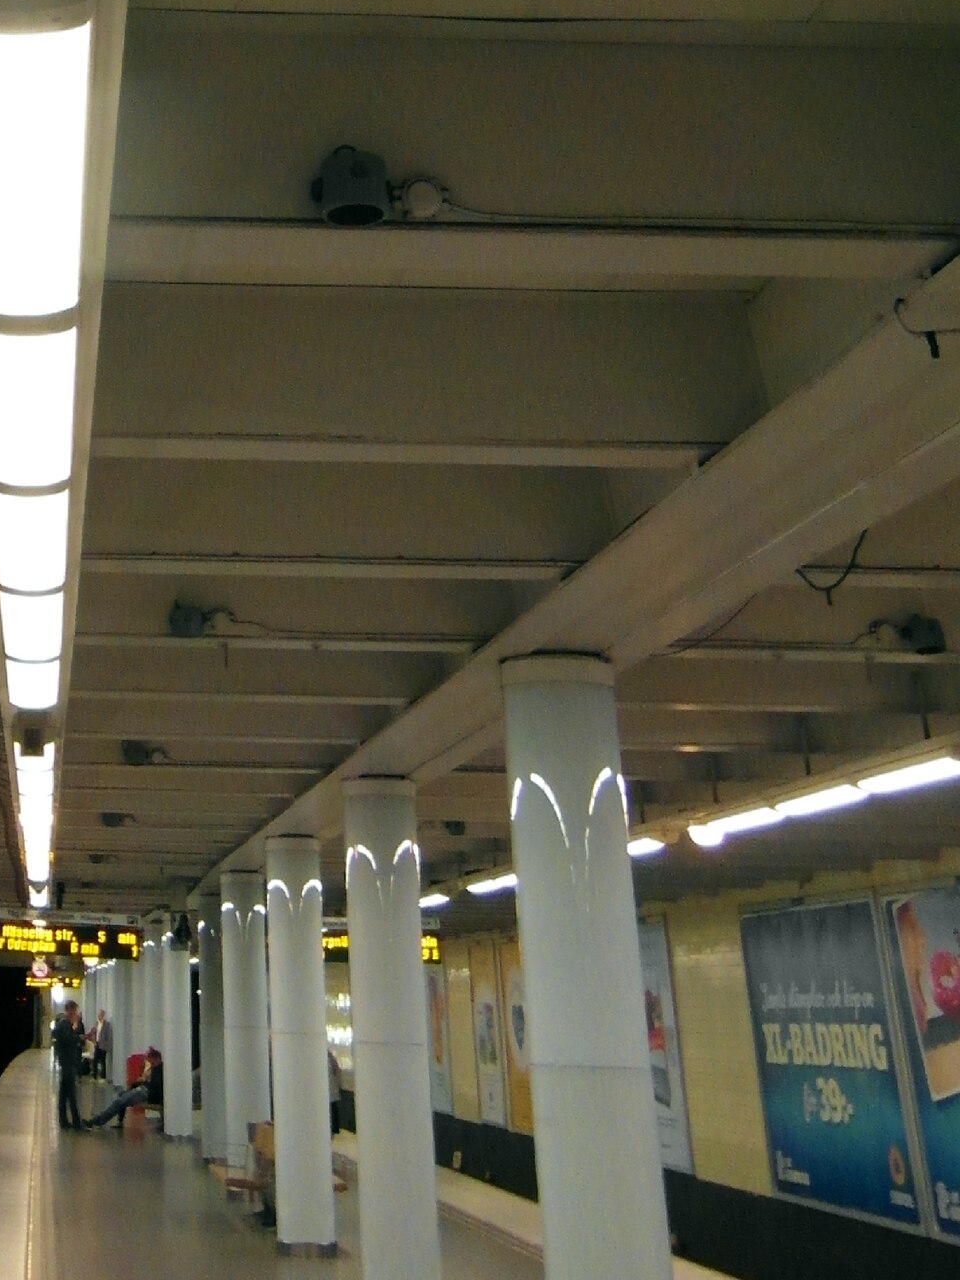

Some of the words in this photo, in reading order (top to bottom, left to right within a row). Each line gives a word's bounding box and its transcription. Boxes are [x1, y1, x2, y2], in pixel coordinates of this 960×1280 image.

[56, 929, 76, 941] str.
[117, 932, 137, 945] min
[7, 938, 57, 953] Odenplan
[80, 943, 99, 955] min
[761, 1022, 889, 1071] XL-BADRING
